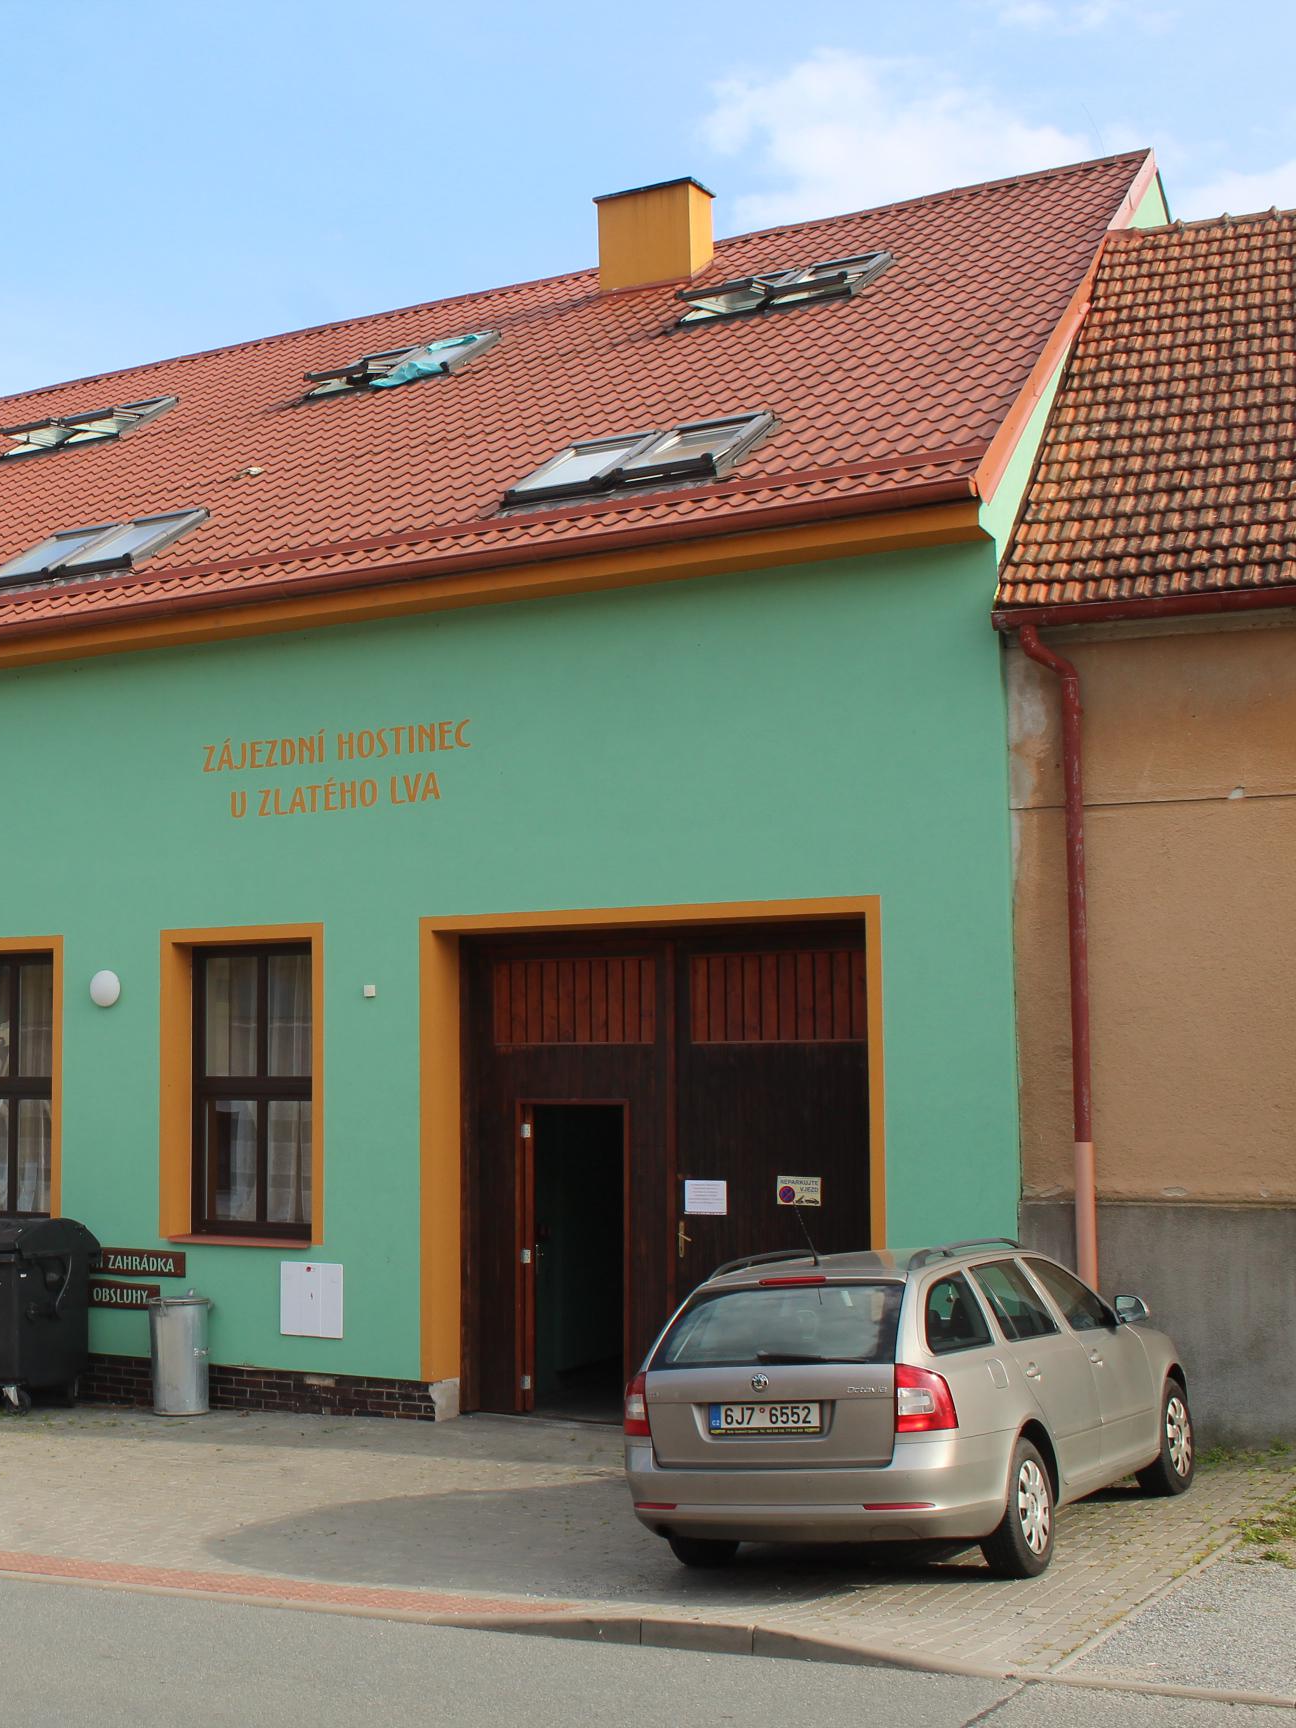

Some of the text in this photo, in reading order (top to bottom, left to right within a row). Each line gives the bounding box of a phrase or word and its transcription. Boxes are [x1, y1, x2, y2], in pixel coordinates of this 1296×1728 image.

[202, 719, 471, 772] ZÁJEZDNÍ HOSTINEC
[229, 772, 441, 818] U ZLATÉHO LVA
[107, 1254, 175, 1273] ZAHRÁDKA
[92, 1287, 149, 1305] OBSLUHY
[724, 1405, 812, 1426] 6J7 6552
